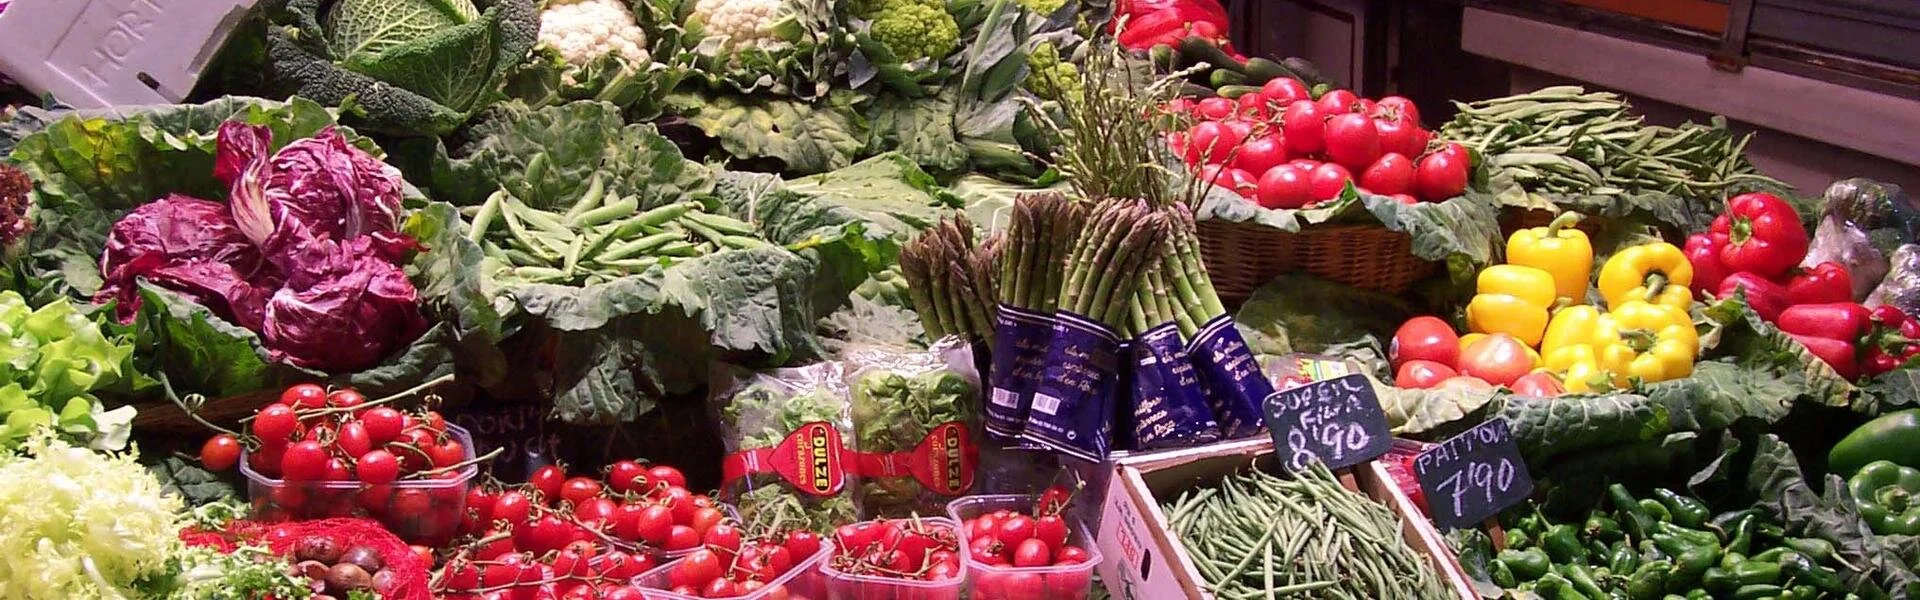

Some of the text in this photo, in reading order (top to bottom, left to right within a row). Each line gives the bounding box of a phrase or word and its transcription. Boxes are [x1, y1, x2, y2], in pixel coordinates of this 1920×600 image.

[813, 436, 828, 488] DULZE
[946, 434, 960, 488] DULZE
[1436, 458, 1515, 517] 7'90
